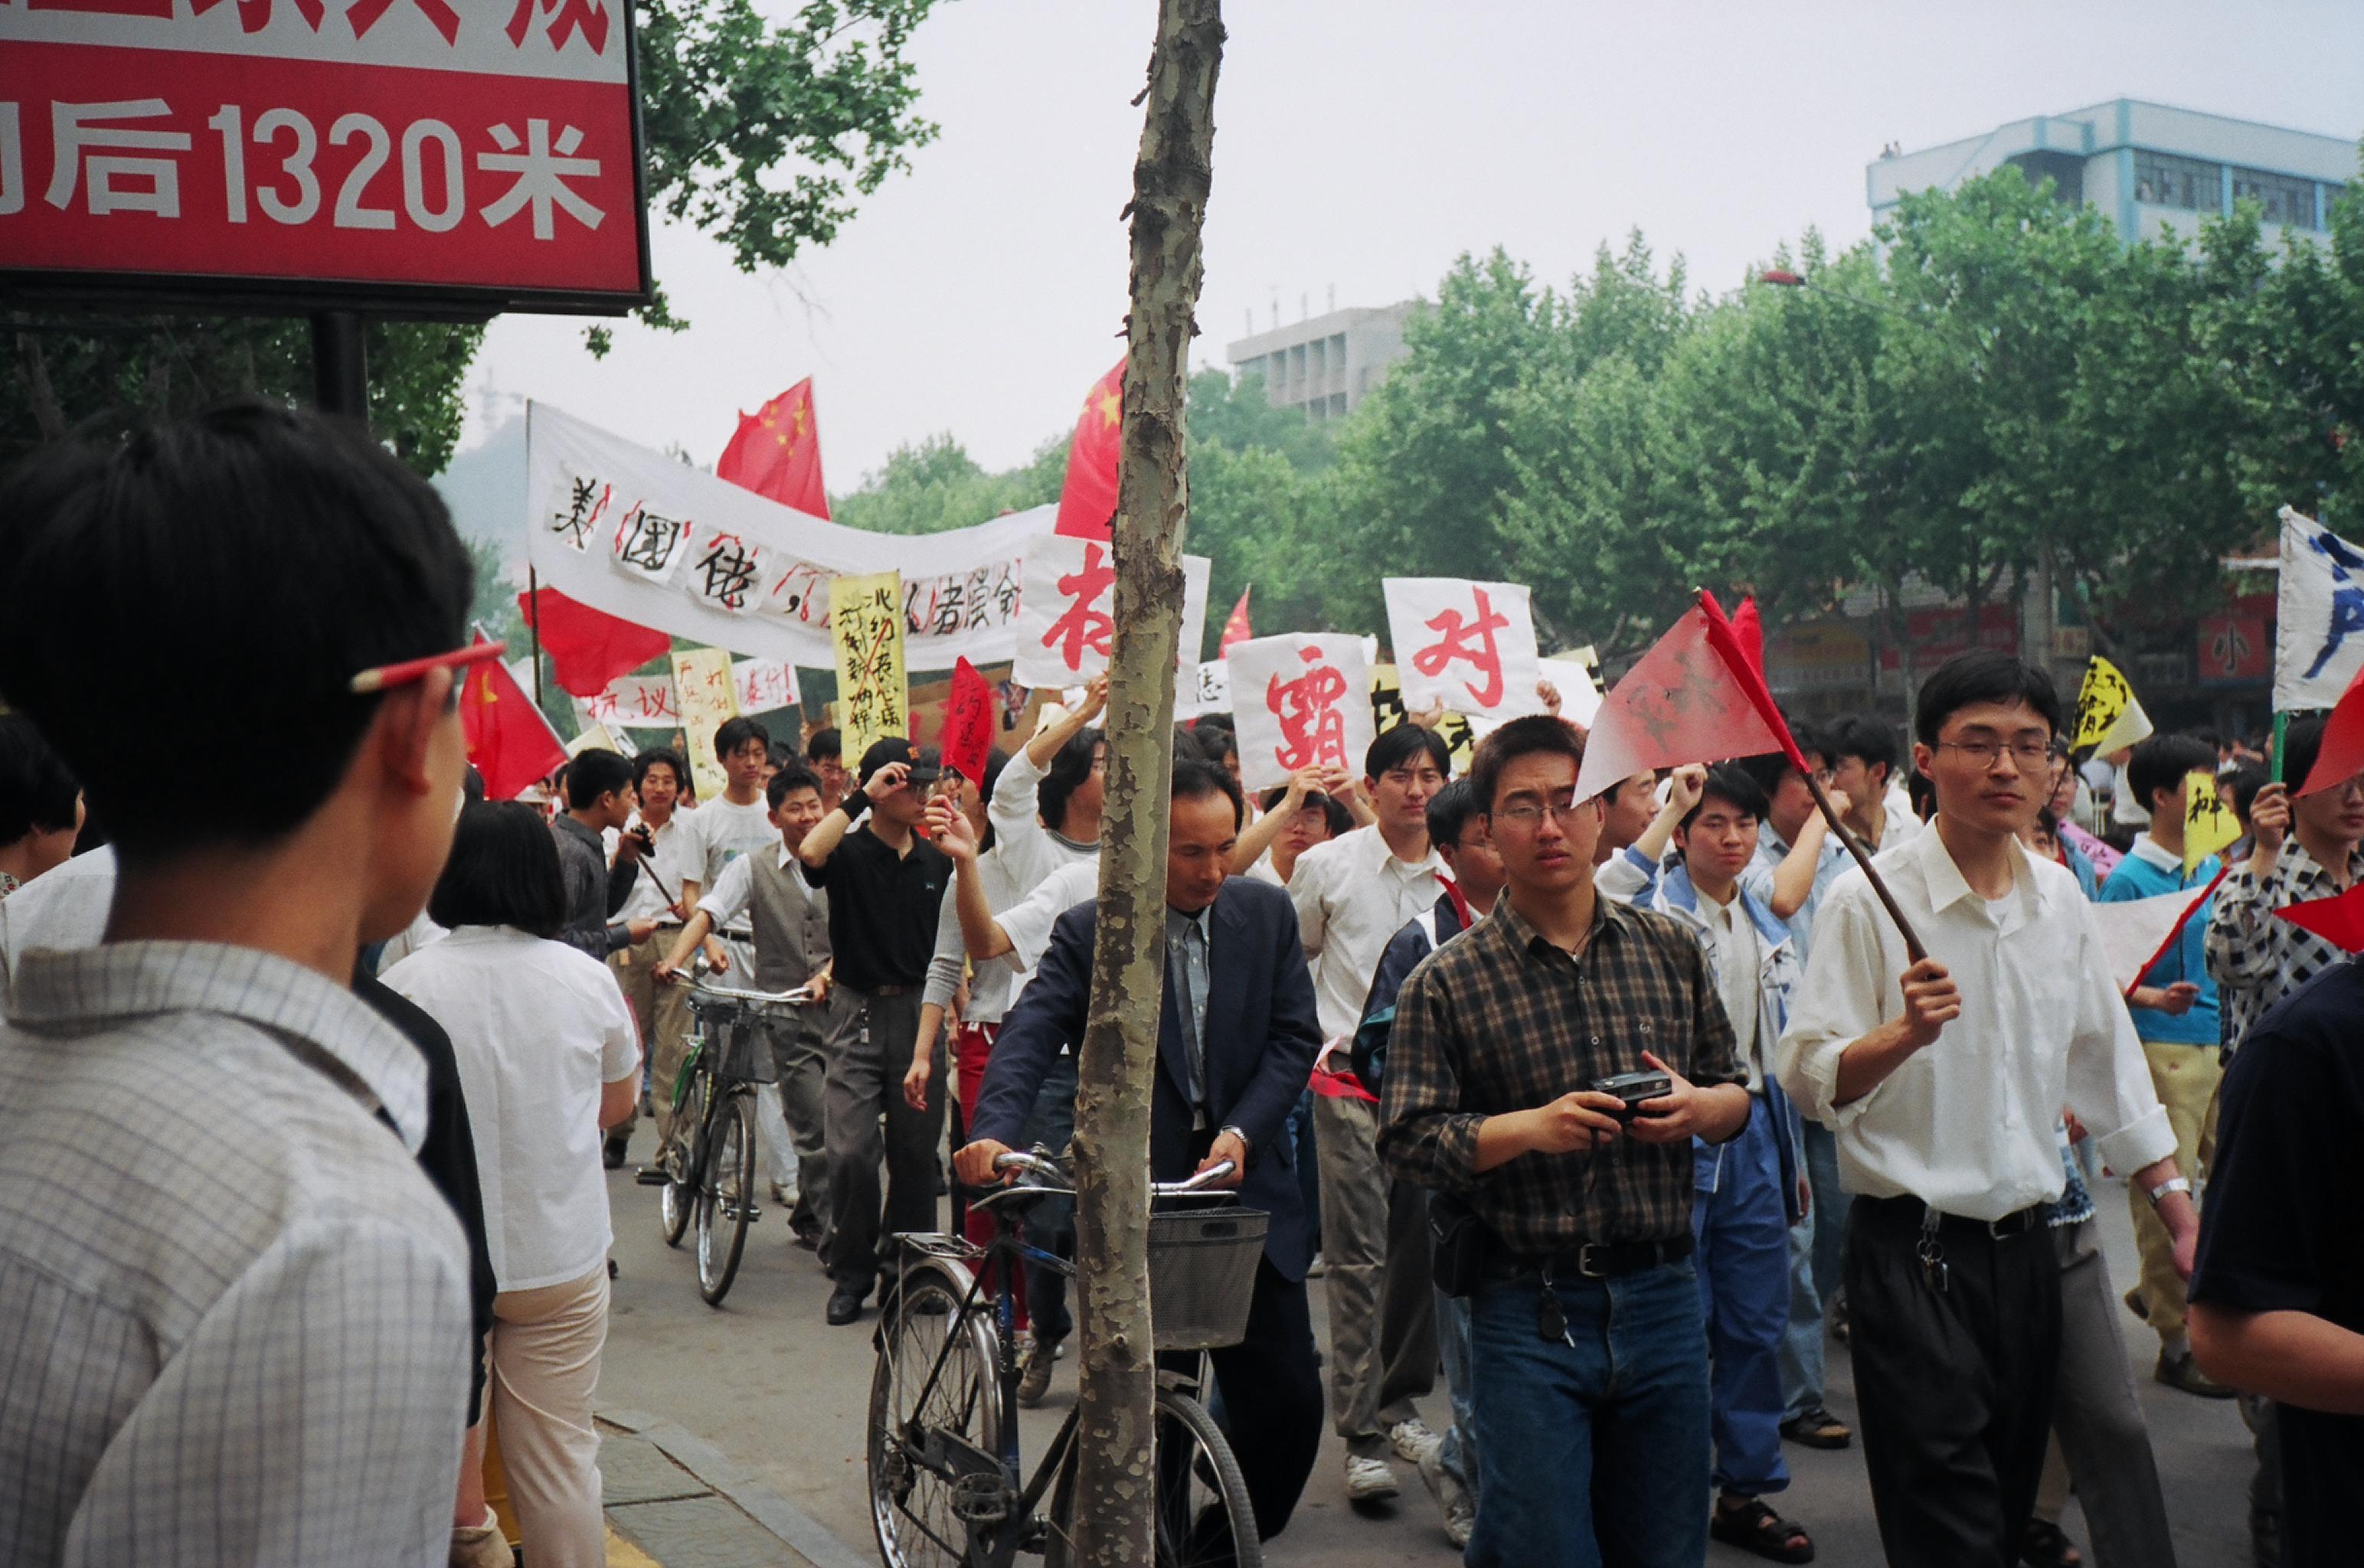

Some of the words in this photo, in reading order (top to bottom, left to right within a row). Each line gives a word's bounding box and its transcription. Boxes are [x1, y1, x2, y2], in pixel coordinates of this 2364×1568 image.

[587, 686, 682, 720] 抗议
[1413, 587, 1509, 708] 对
[1266, 645, 1349, 773] 霸
